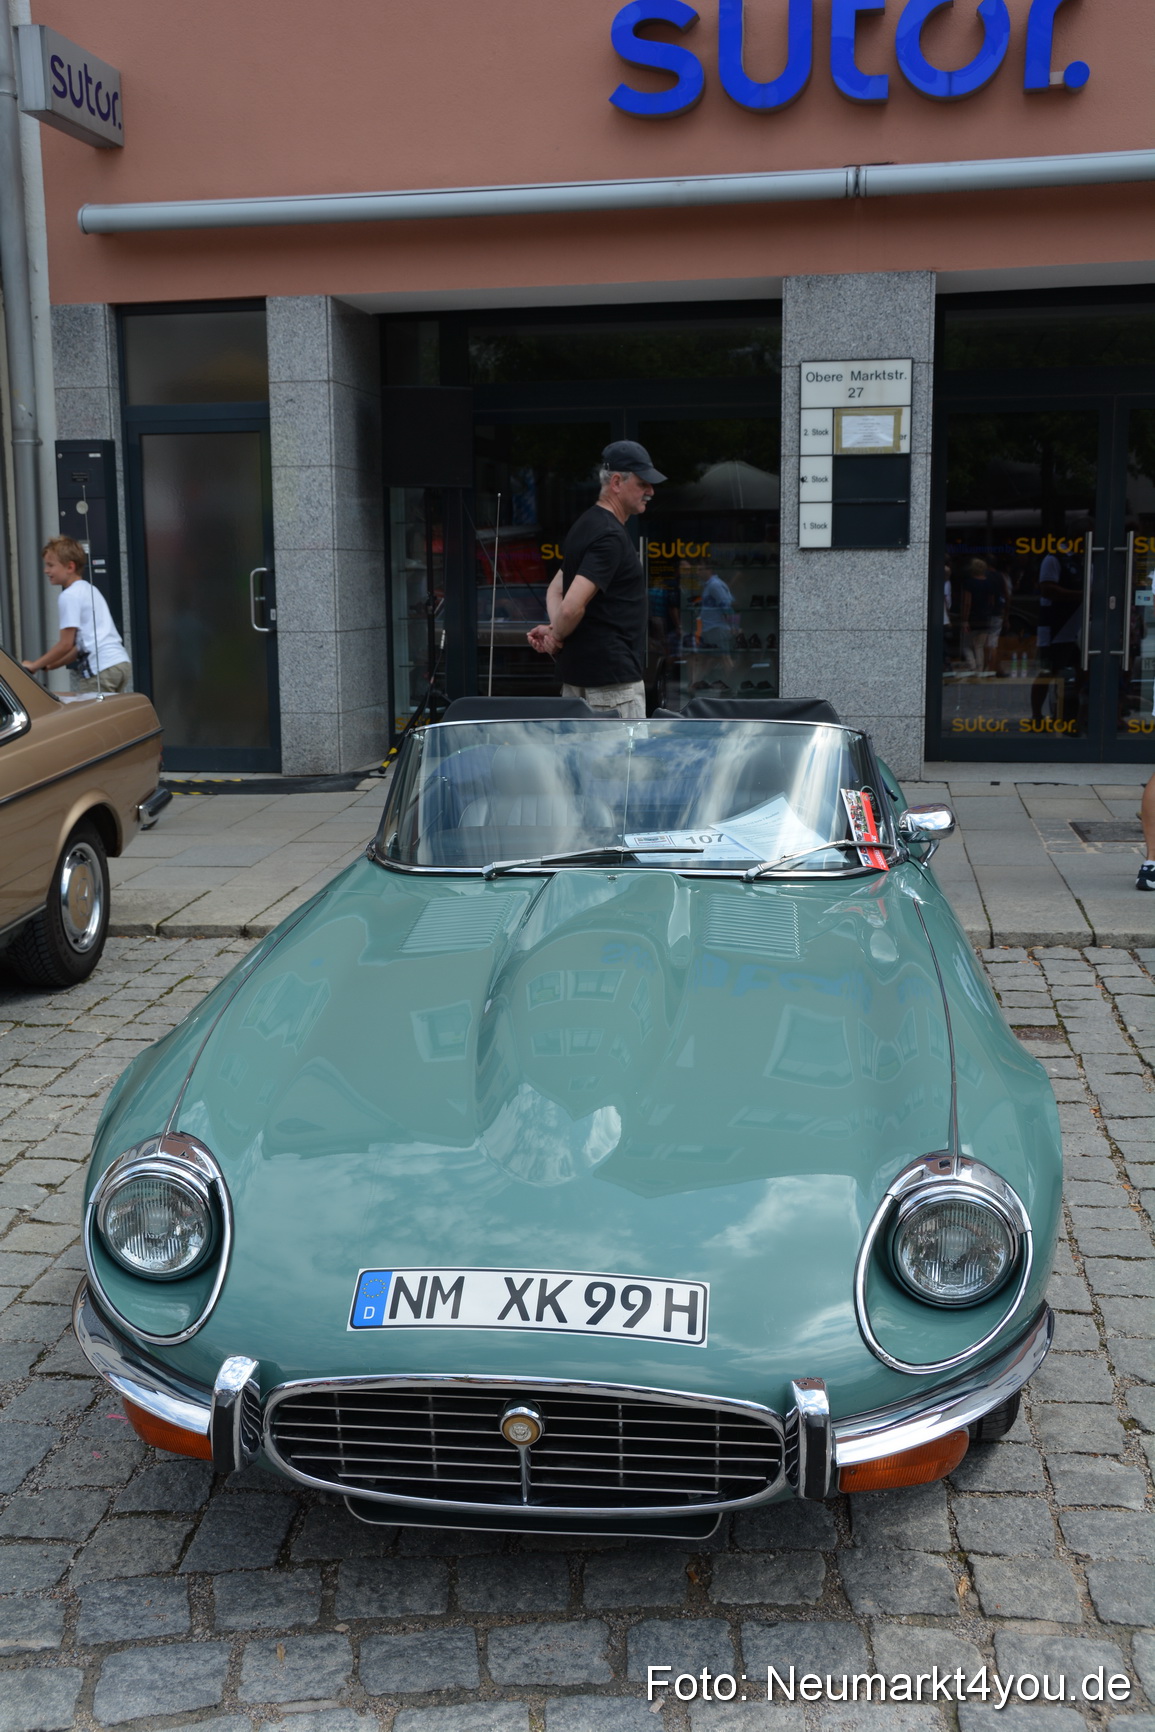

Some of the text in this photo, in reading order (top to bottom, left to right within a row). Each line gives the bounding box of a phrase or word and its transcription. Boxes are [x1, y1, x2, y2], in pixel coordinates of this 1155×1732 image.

[609, 0, 1090, 118] sutor.
[50, 54, 122, 130] sutor.
[805, 369, 908, 383] Obere Marktstr.
[848, 387, 864, 399] 27
[812, 428, 829, 437] Stock
[811, 475, 829, 483] Stock
[809, 522, 828, 530] Stock
[648, 537, 712, 559] sutor.
[1015, 533, 1084, 554] sutor.
[951, 715, 1077, 733] sutor. sutor.
[685, 833, 724, 846] 107
[388, 1275, 465, 1320] NM
[497, 1276, 573, 1324] XK
[363, 1306, 375, 1320] D
